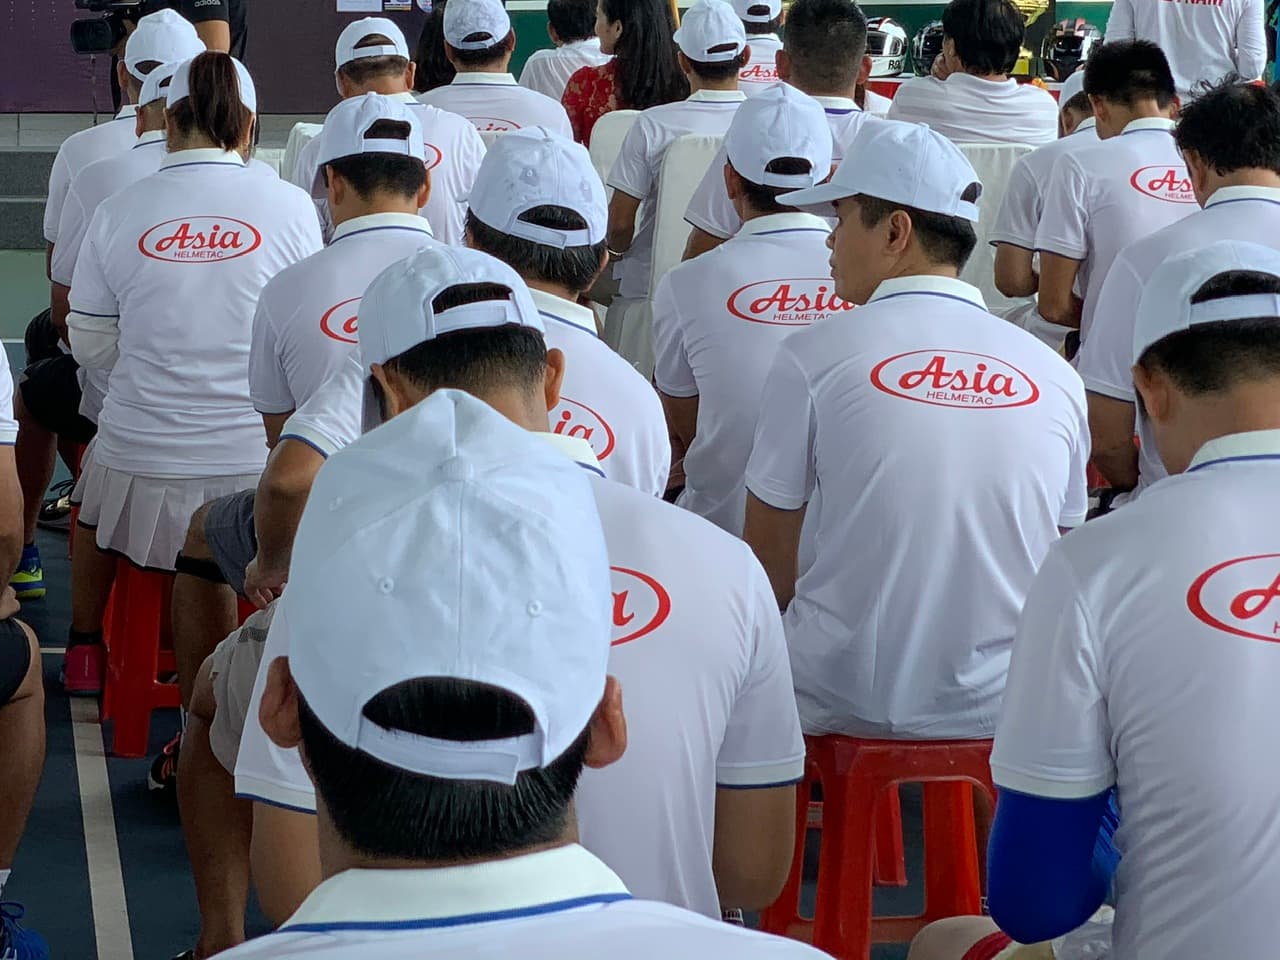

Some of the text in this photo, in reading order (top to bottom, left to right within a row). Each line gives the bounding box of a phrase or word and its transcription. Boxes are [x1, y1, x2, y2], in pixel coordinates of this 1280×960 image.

[740, 64, 779, 78] Asi
[1148, 170, 1193, 192] As
[154, 223, 244, 250] Asia
[173, 250, 224, 259] HELMETAC
[898, 356, 1019, 398] Asia
[925, 390, 993, 405] HELMETAC
